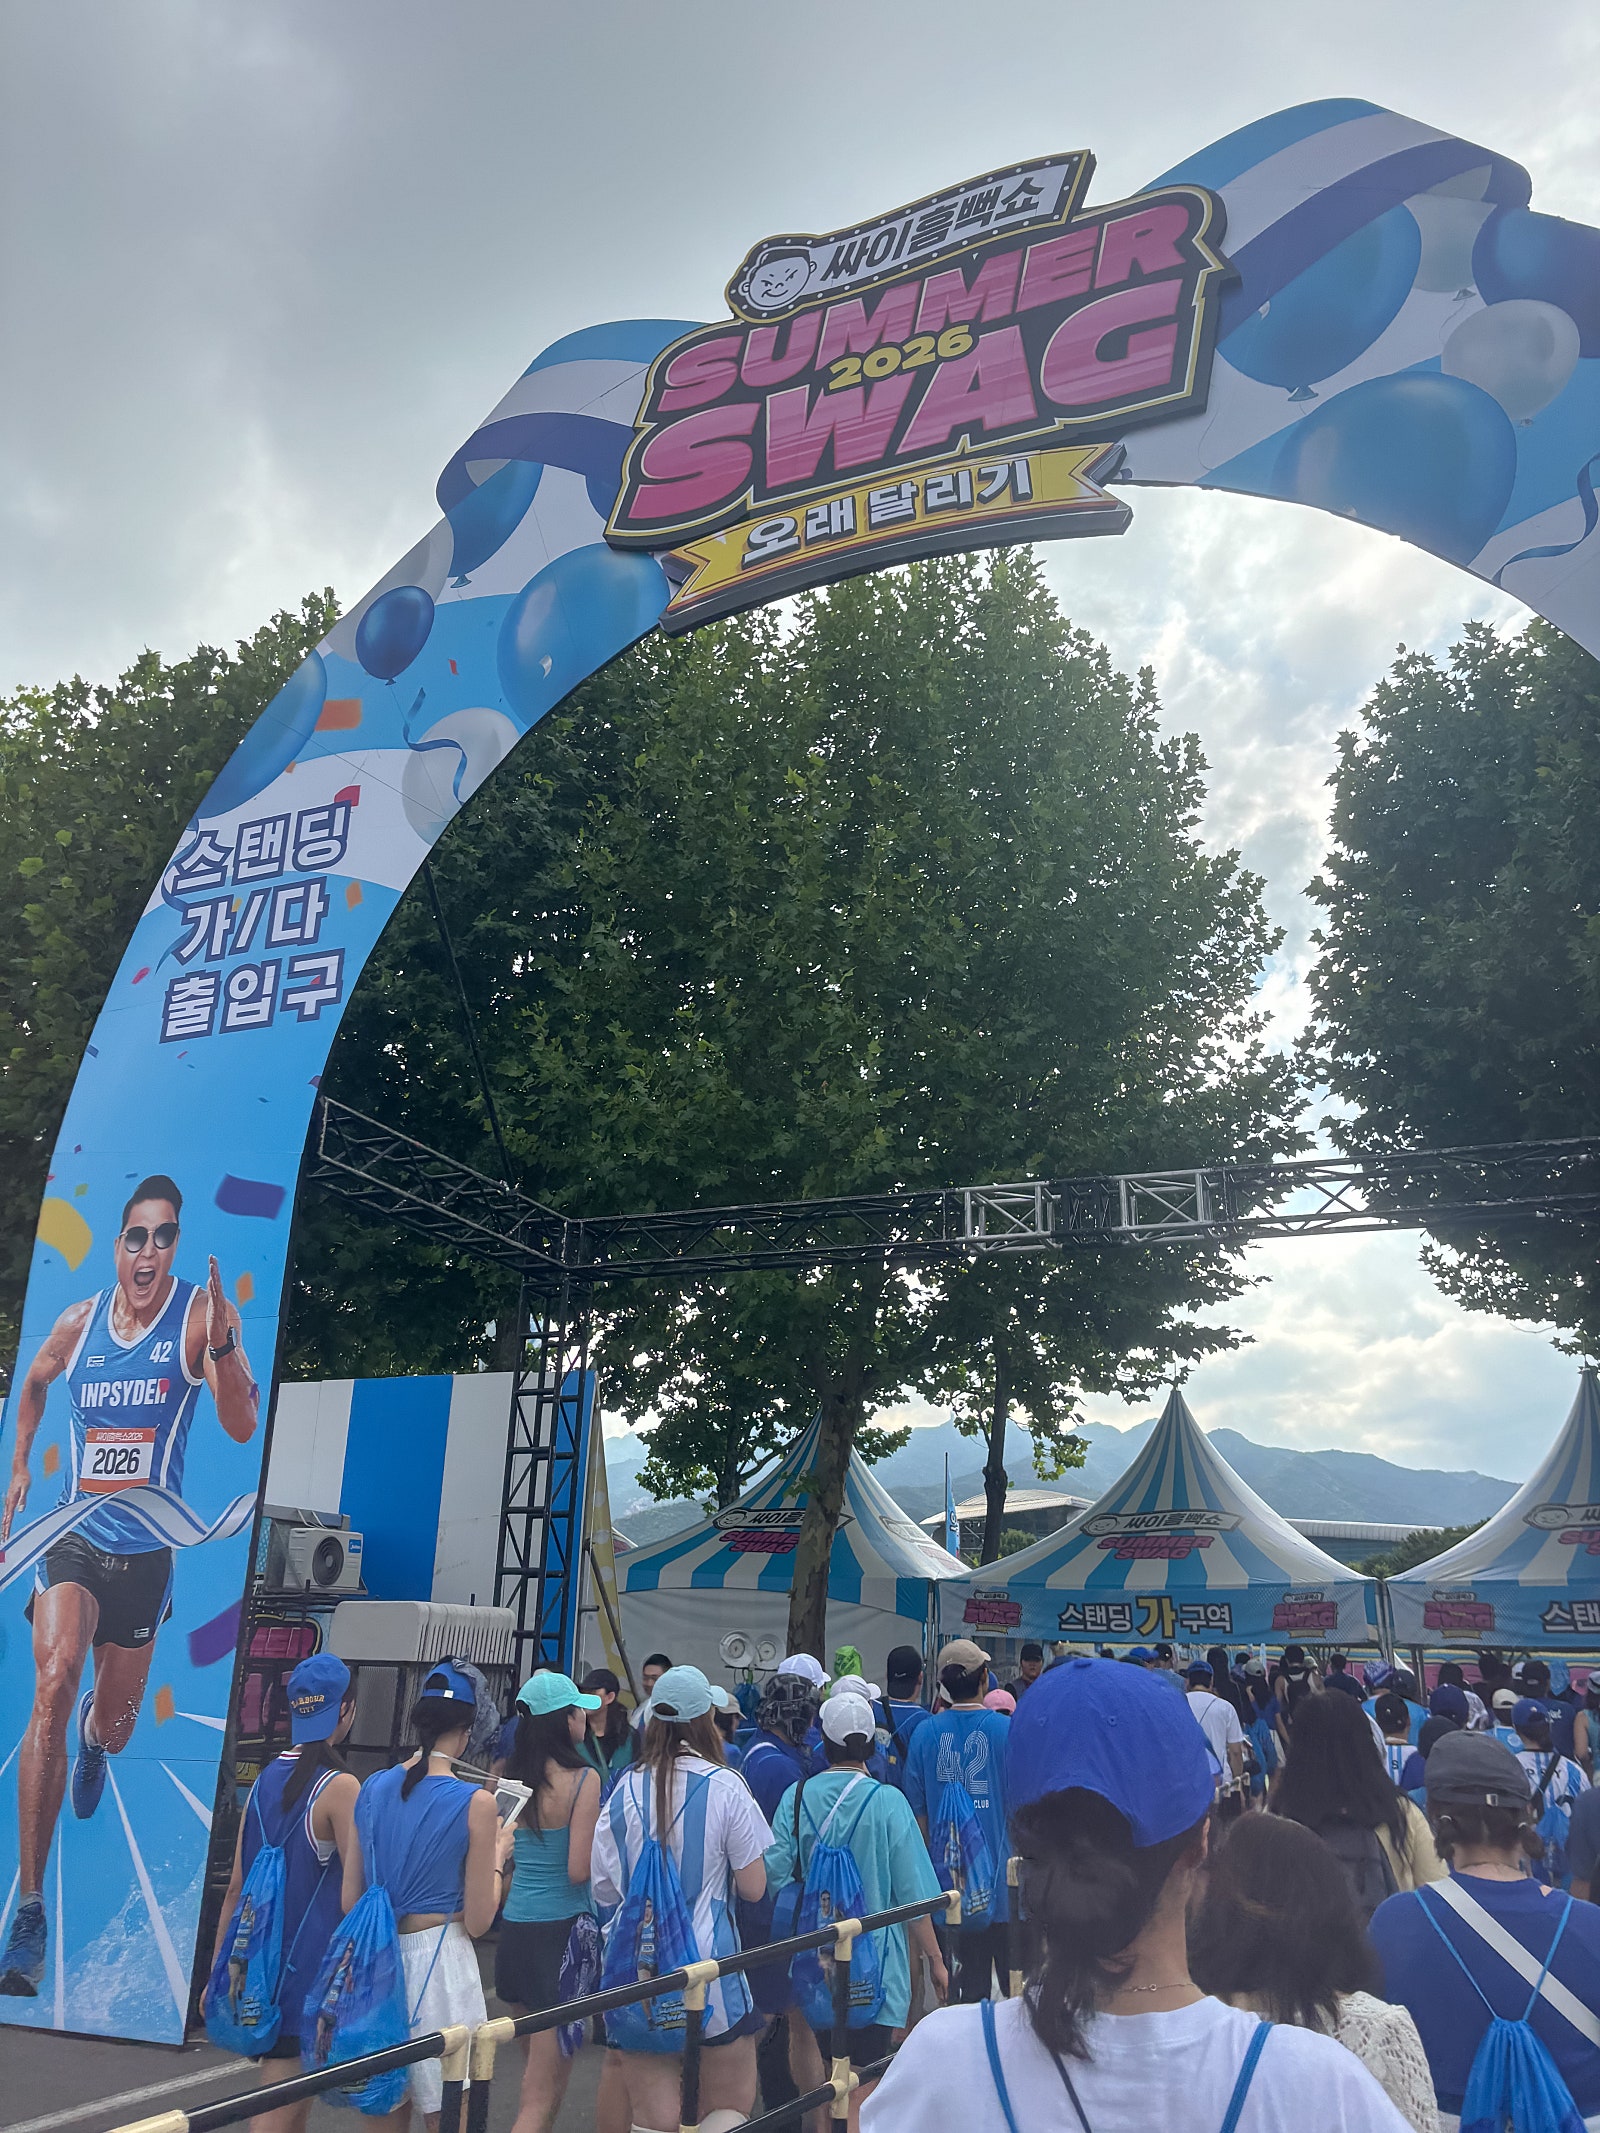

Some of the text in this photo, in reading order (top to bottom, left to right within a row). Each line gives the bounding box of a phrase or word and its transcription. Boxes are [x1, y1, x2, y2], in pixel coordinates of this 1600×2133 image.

[819, 177, 1045, 282] 싸이흠뻑쇼
[659, 203, 1190, 413] SUMMER
[828, 324, 974, 391] 2026
[629, 279, 1184, 521] SWAG
[172, 801, 350, 895] 스탠딩
[174, 877, 330, 964] 가/다
[160, 949, 345, 1043] 출입구
[149, 1341, 171, 1363] 42
[92, 1448, 140, 1474] 2026
[720, 1531, 800, 1544] SUMME
[1123, 1513, 1224, 1529] 싸이흠뻑쇼
[729, 1541, 795, 1553] SWAG
[1097, 1536, 1215, 1549] SUMMER
[1114, 1548, 1192, 1559] SWAG
[1059, 1596, 1233, 1638] 스탠딩 가 구역
[1540, 1602, 1600, 1632] 스탠
[936, 1730, 989, 1795] 42
[973, 1799, 990, 1809] CLUB
